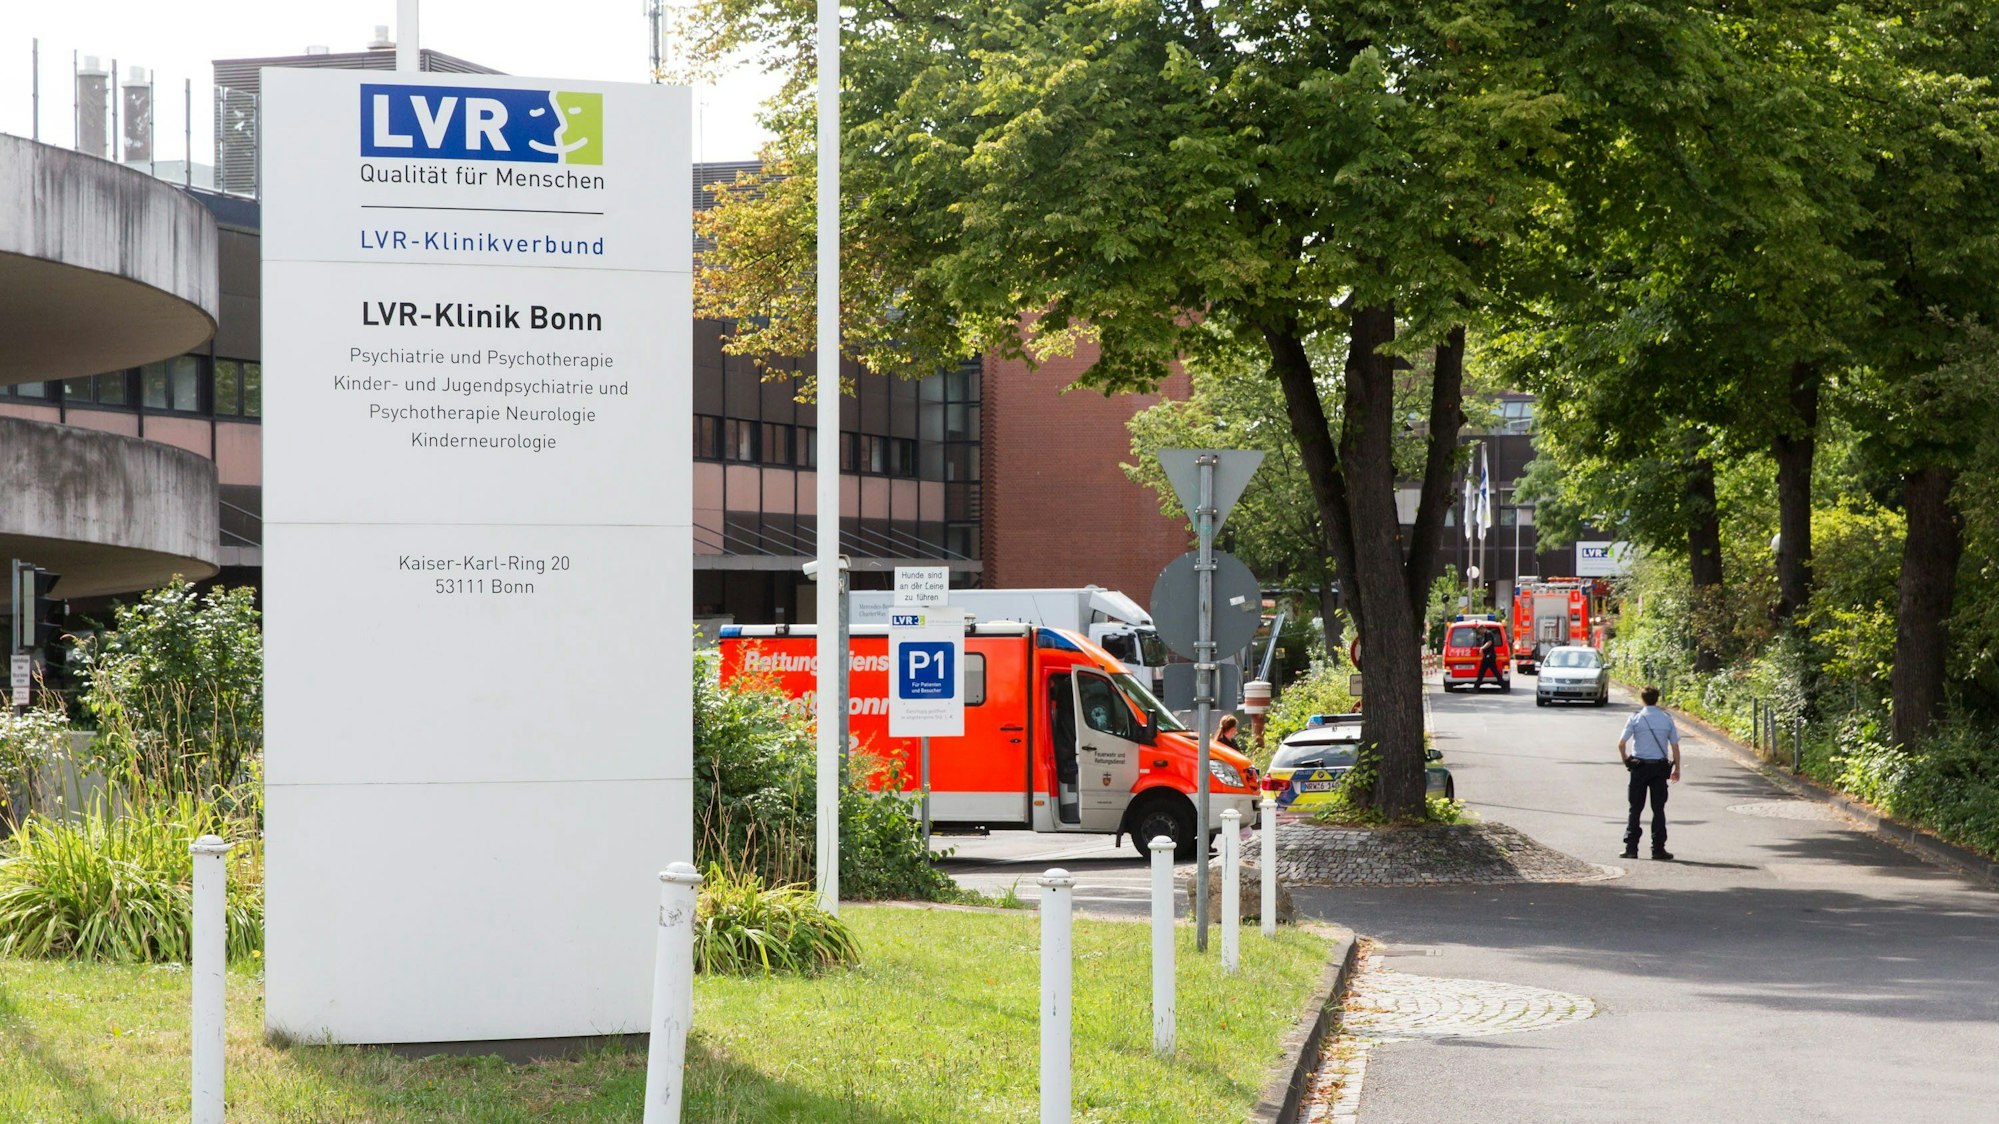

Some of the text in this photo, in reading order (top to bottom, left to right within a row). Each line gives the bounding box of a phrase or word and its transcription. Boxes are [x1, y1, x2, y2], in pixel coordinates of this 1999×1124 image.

[373, 94, 511, 152] LVR
[361, 163, 605, 190] Qualität für Menschen
[361, 229, 604, 256] LVR-Klinikverbund
[362, 301, 602, 331] LVR-Klinik Bonn
[350, 347, 614, 371] Psychiatrie und Psychotherapie
[334, 375, 629, 397] Kinder- und Jugendpsychiatrie und
[369, 403, 596, 426] Psychotherapie Neurologie
[411, 432, 557, 453] Kinderneurologie
[1583, 549, 1602, 557] LVR
[399, 555, 570, 575] Kaiser-Karl-Ring 20
[901, 571, 943, 579] Hunde sind
[435, 578, 534, 594] 53111 Bonn
[916, 593, 939, 601] führen
[893, 616, 913, 625] LVR
[744, 650, 889, 677] Rettungiens
[908, 650, 945, 680] P1
